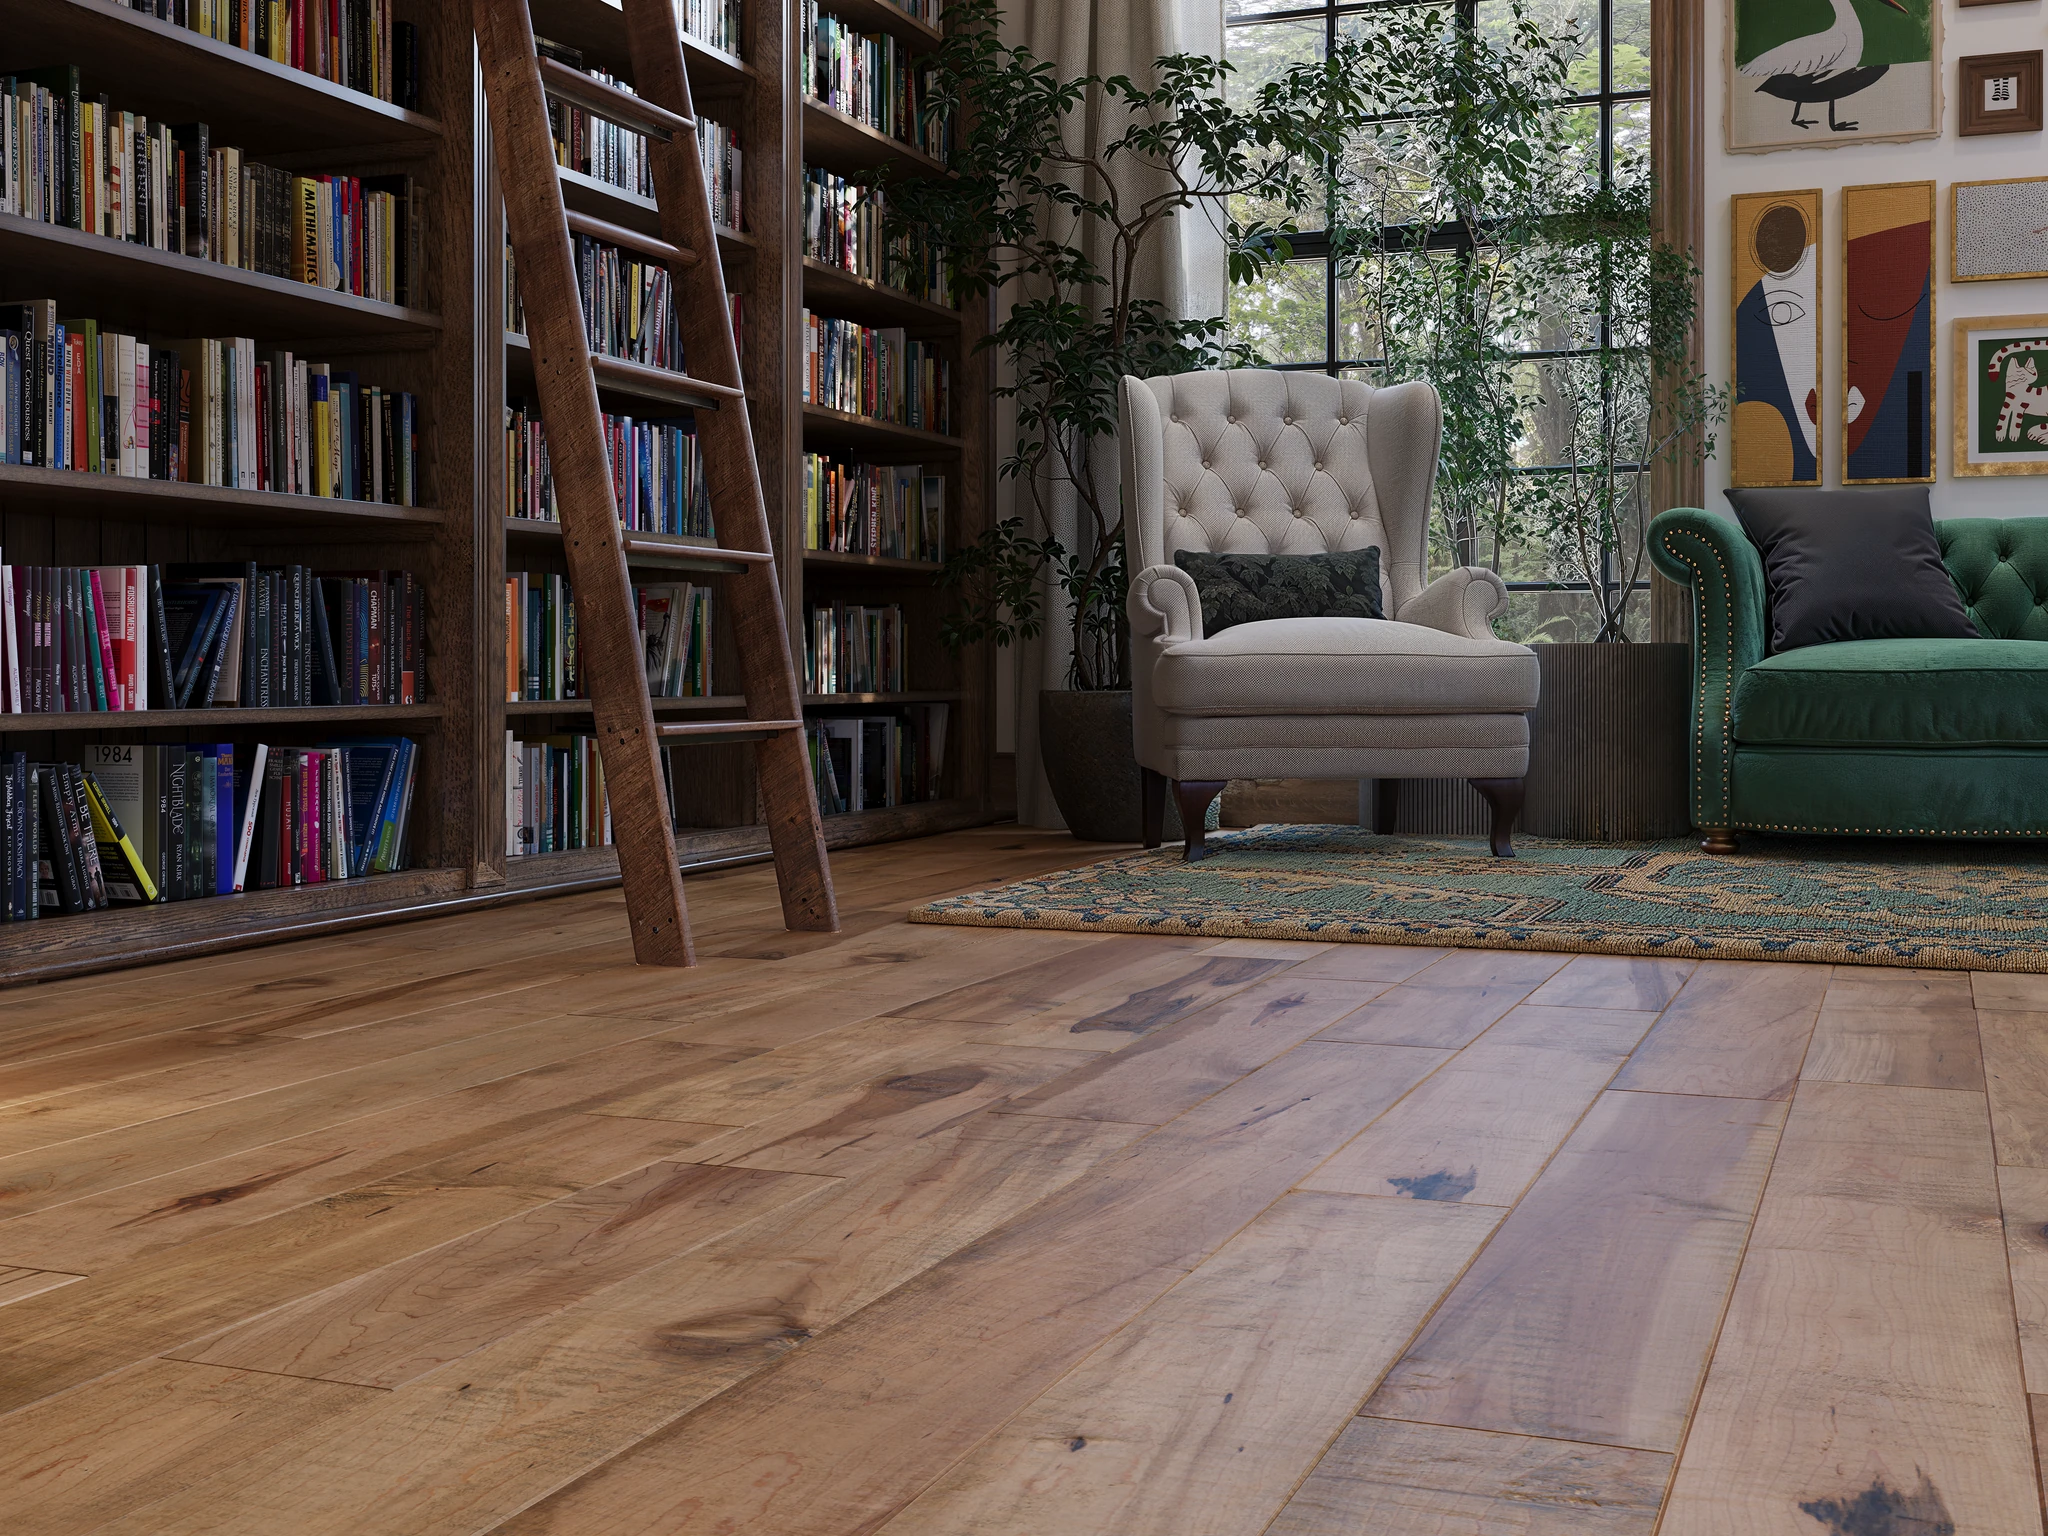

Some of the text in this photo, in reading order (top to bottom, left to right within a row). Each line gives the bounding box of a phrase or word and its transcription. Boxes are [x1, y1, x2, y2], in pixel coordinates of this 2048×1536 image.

[305, 188, 318, 284] MATHEMATICS
[55, 344, 64, 408] intelligence
[94, 745, 133, 763] 1984
[79, 805, 90, 821] BE
[84, 824, 99, 865] THERE
